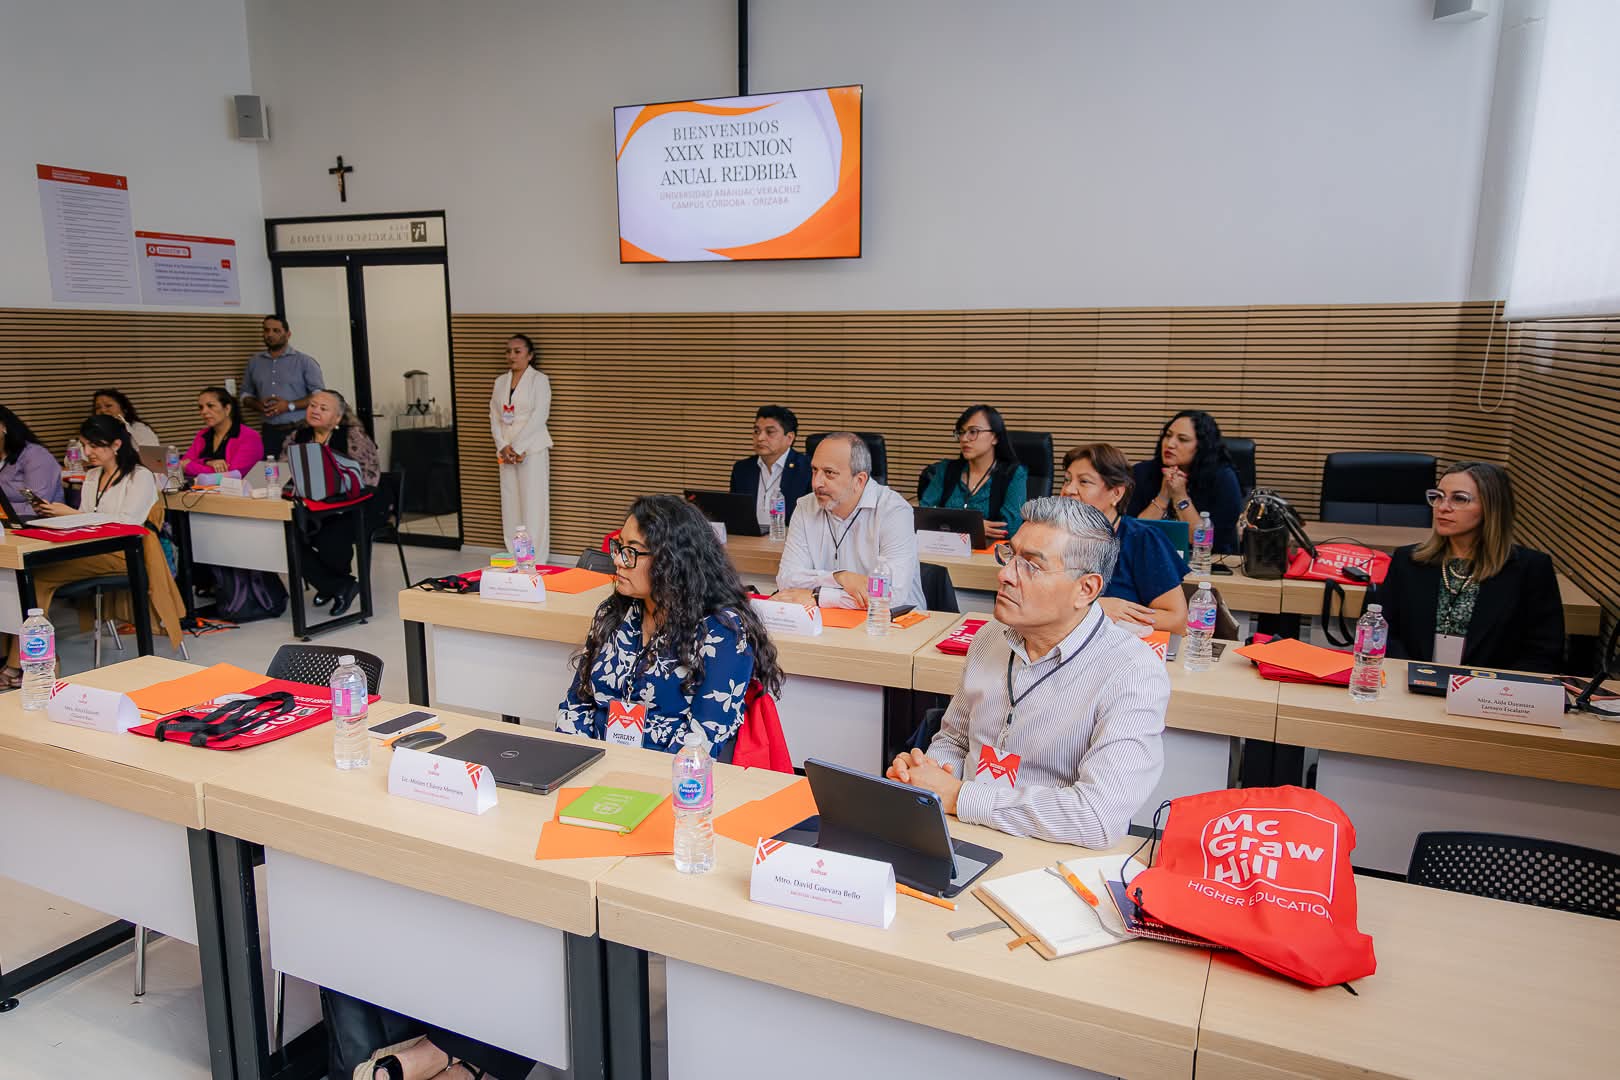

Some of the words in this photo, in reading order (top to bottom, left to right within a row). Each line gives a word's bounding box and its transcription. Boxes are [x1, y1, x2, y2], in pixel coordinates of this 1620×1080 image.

[673, 120, 780, 141] BIENVENIDOS
[664, 143, 704, 162] XXIX
[713, 137, 793, 159] REUNION
[660, 167, 717, 186] ANUAL
[721, 162, 797, 183] REDBIBA
[660, 189, 713, 200] UNIVERSIDAD
[757, 184, 801, 195] VERACRUZ
[671, 200, 705, 210] CAMPUS
[752, 196, 789, 206] ORIZABA
[612, 732, 635, 742] MIRIAM
[1212, 813, 1280, 836] Mc
[1208, 833, 1325, 862] Graw
[1214, 852, 1279, 884] Hill
[774, 875, 792, 885] Mtro.
[793, 879, 813, 890] David
[814, 884, 842, 896] Guevara
[843, 891, 861, 900] Bello
[1187, 880, 1245, 907] HIGHER
